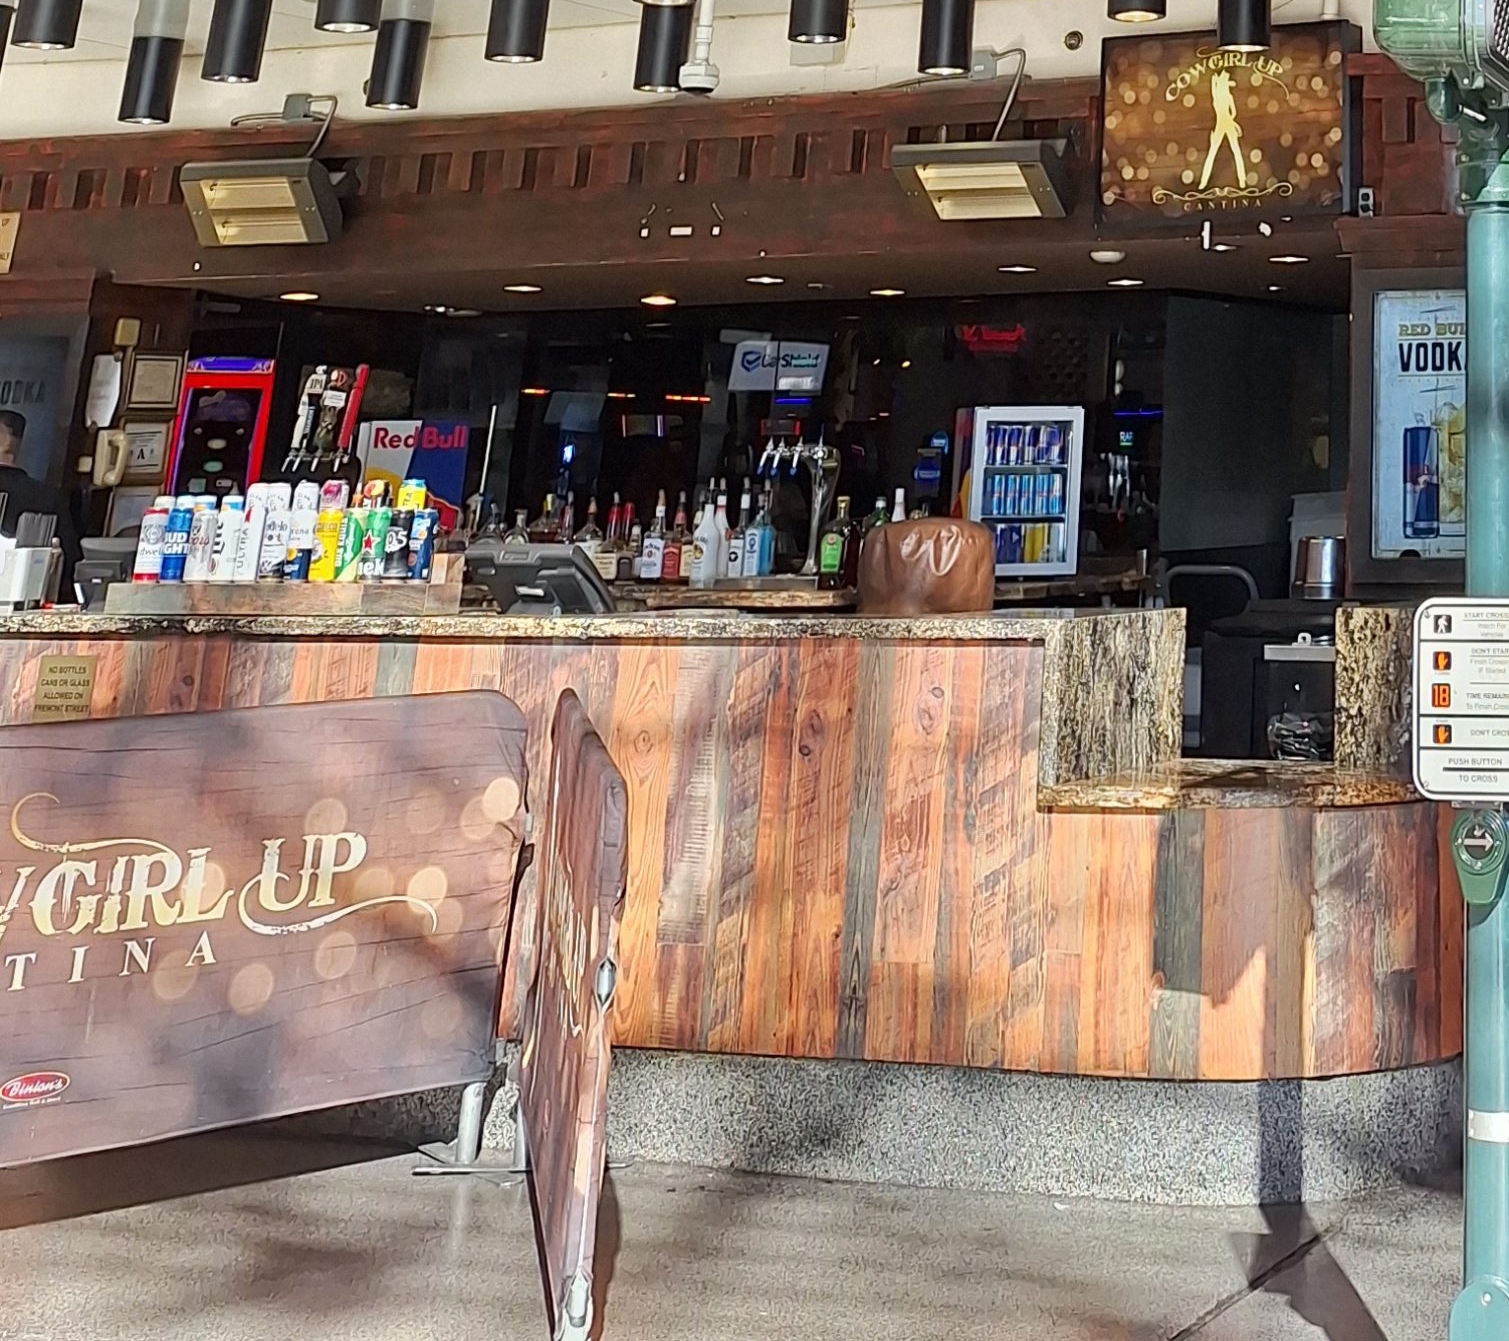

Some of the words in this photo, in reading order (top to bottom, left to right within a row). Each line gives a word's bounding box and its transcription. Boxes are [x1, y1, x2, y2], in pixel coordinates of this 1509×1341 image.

[1165, 52, 1252, 102] COWGIRL
[1255, 54, 1285, 78] UP
[1183, 199, 1263, 212] CANTINA
[1398, 323, 1432, 337] RED
[1398, 340, 1467, 373] VODK
[0, 380, 45, 405] ODKA
[373, 425, 419, 449] Red
[422, 425, 468, 450] Bull
[1433, 684, 1449, 706] 18
[1448, 757, 1469, 766] PUSH
[1471, 757, 1503, 766] BUTTON
[1459, 774, 1470, 783] TO
[1471, 774, 1498, 783] CROSS
[0, 844, 236, 941] GIRL
[250, 830, 369, 917] UP
[3, 930, 218, 992] TINA
